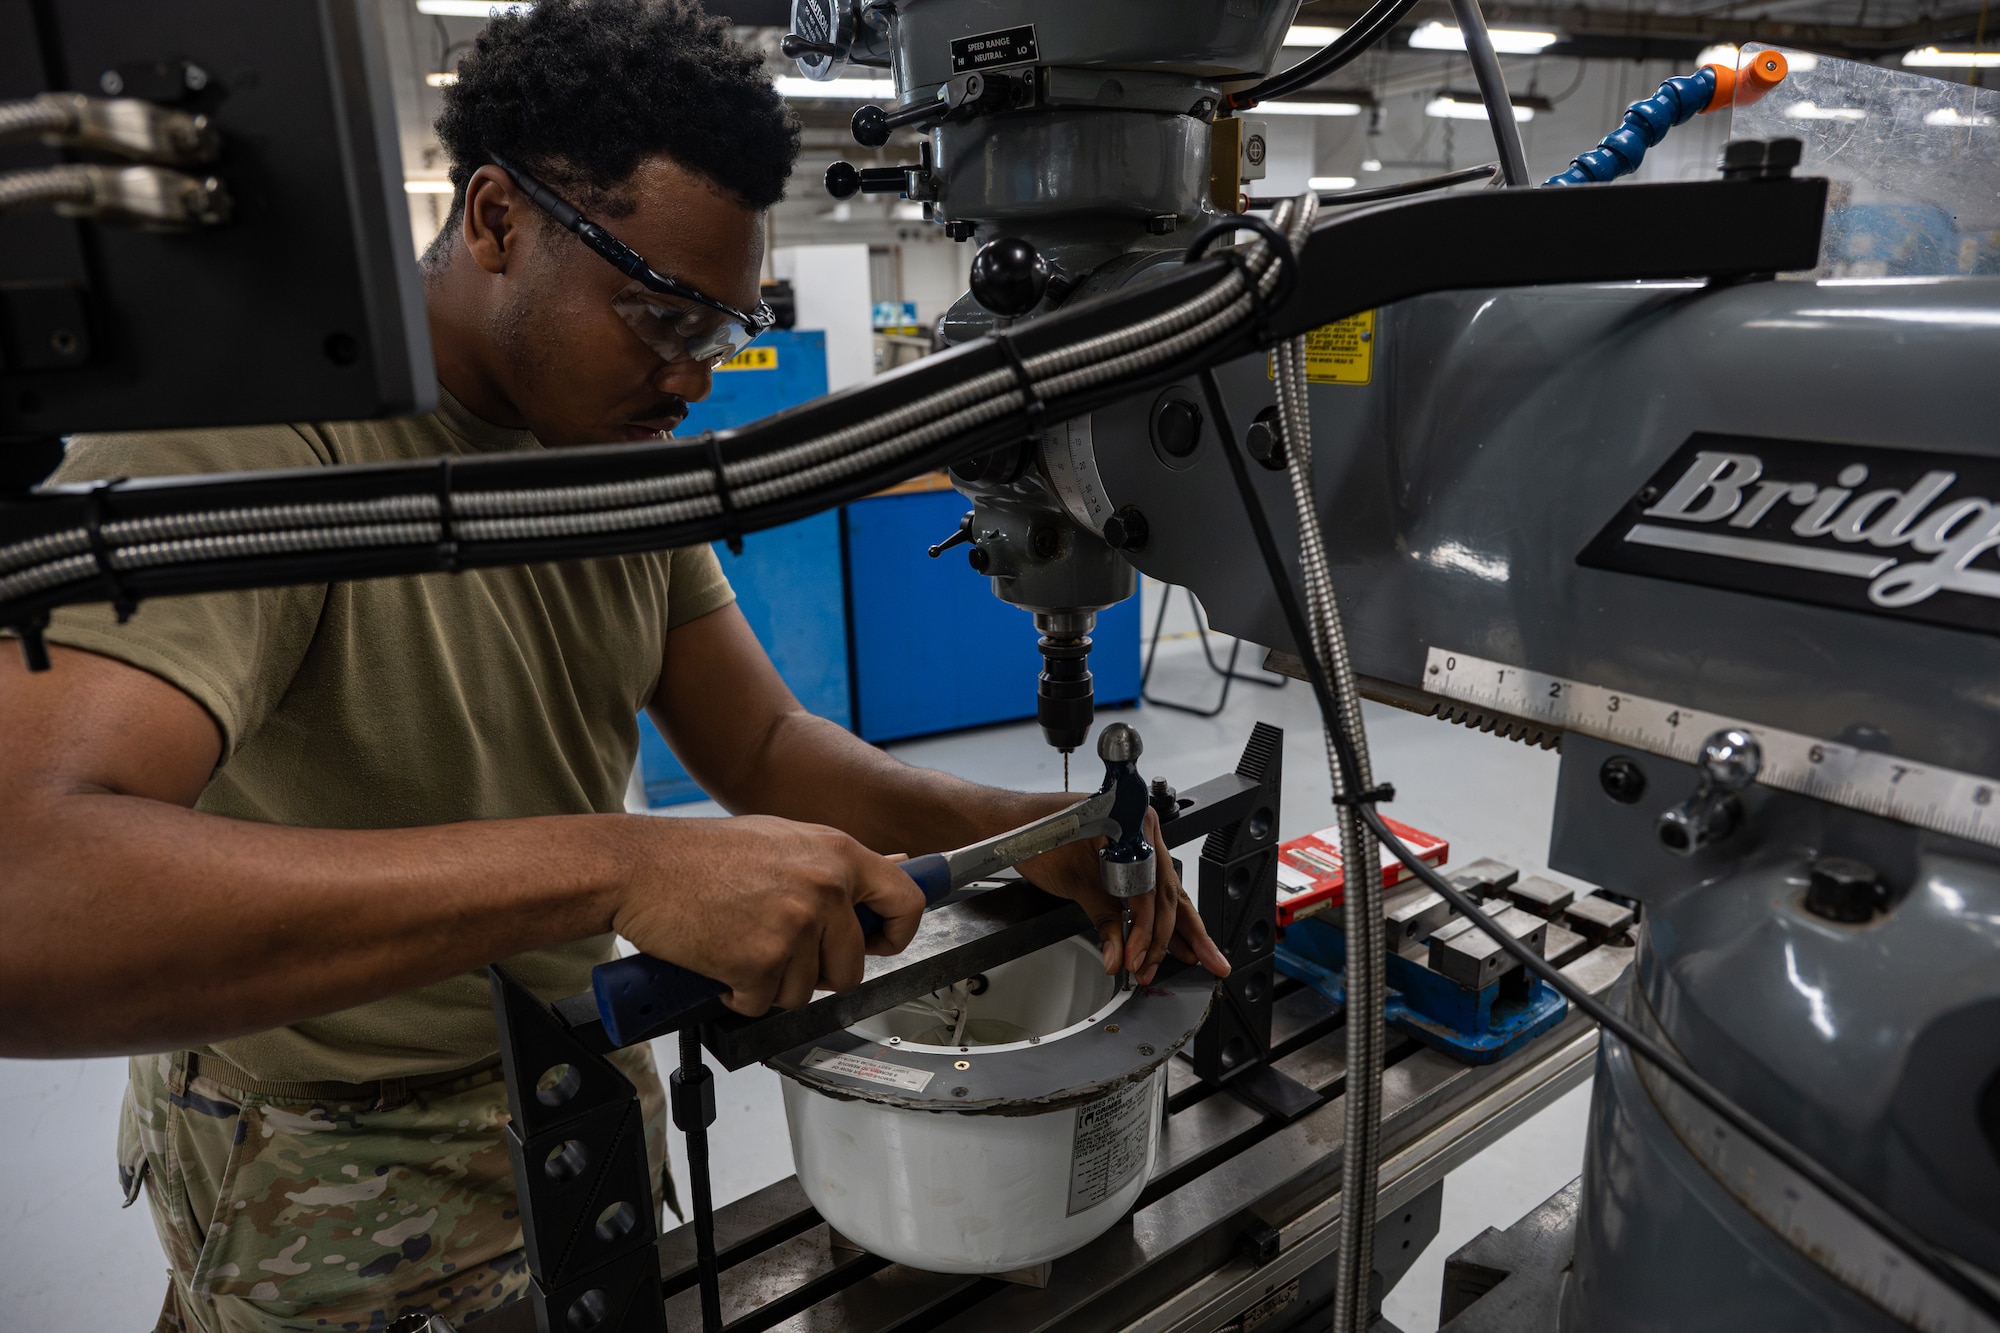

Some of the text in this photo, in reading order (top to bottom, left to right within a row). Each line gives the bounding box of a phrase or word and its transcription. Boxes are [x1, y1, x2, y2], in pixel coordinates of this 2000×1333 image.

[810, 0, 829, 32] AUTION
[968, 37, 1010, 52] SPEED RANGE
[958, 46, 1028, 66] HI NEUTRAL LO
[1643, 451, 2000, 607] Bridg
[1446, 657, 1456, 671] 0
[1081, 1100, 1106, 1115] GRIMES
[1094, 1097, 1133, 1123] AEROSPACE
[1095, 1098, 1122, 1116] GRIMES
[1076, 1150, 1088, 1160] DATE
